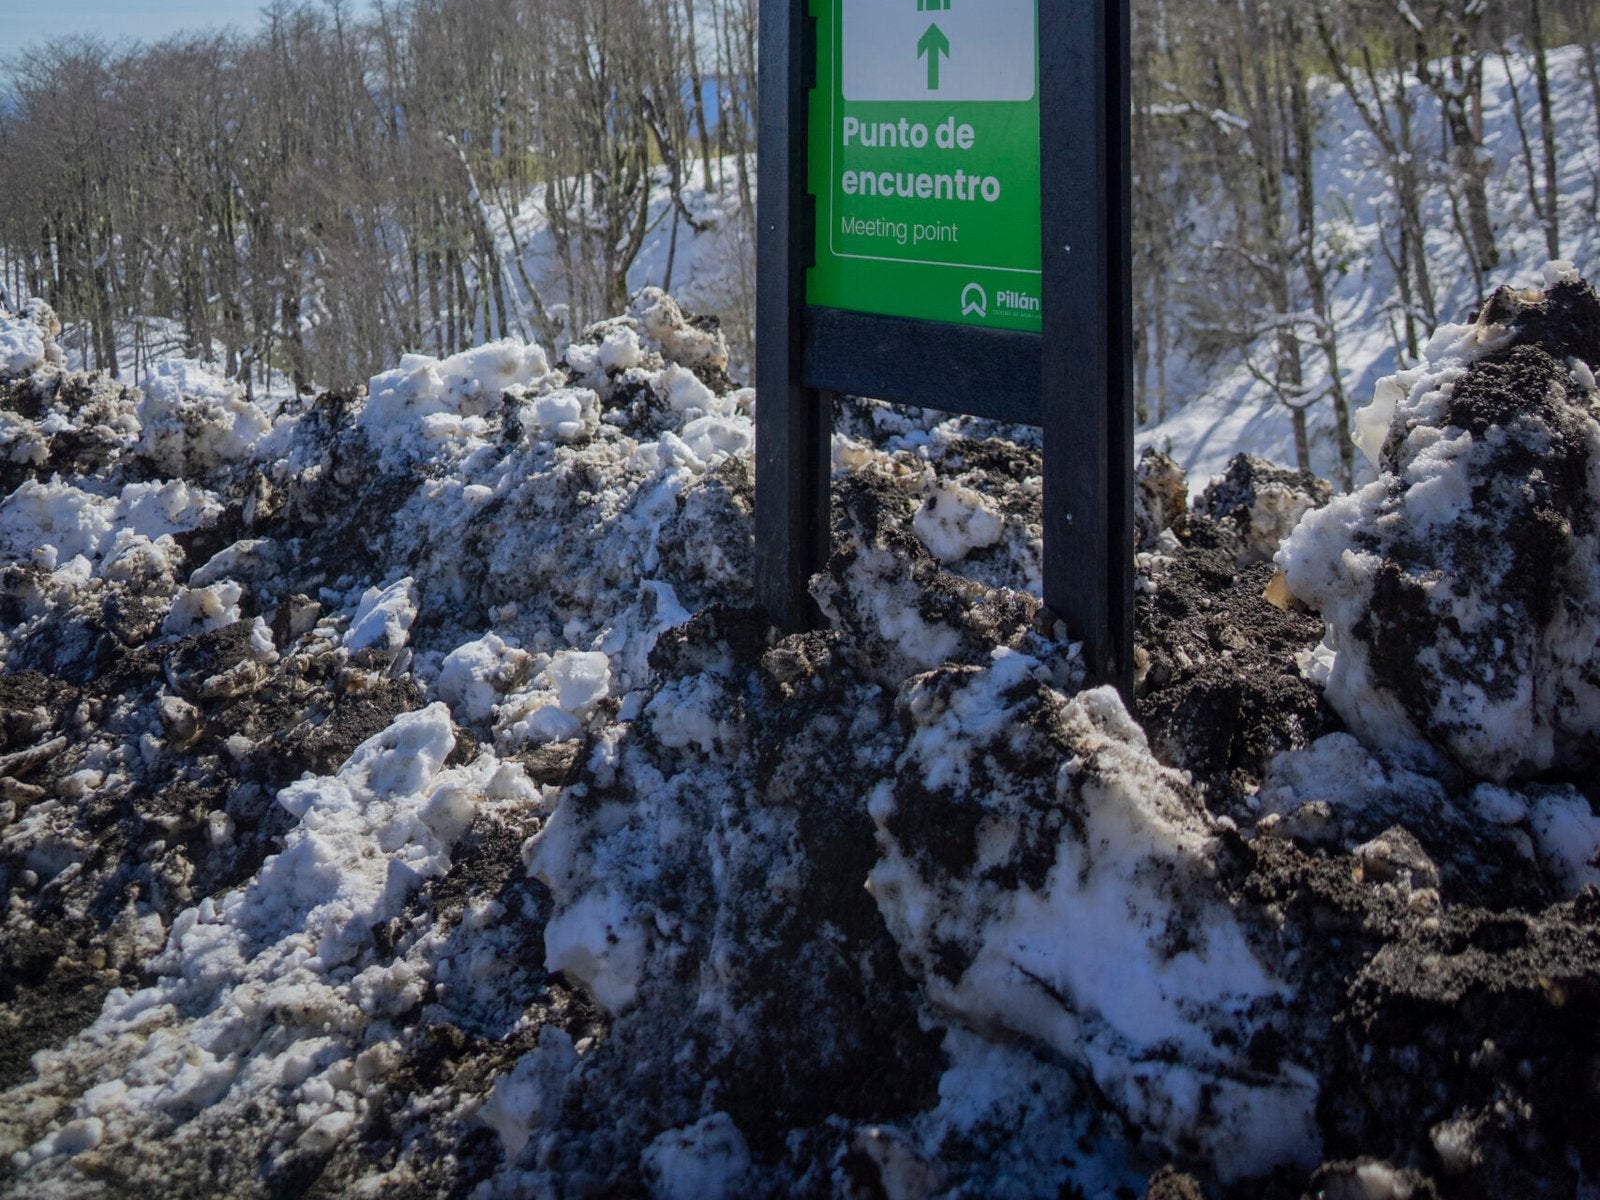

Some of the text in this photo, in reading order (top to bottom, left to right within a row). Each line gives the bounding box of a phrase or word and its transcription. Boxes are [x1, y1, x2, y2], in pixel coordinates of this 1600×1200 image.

[843, 116, 975, 150] Punto de
[842, 169, 1001, 202] encuentro
[841, 216, 958, 246] Meeting point
[997, 290, 1039, 310] Pillán
